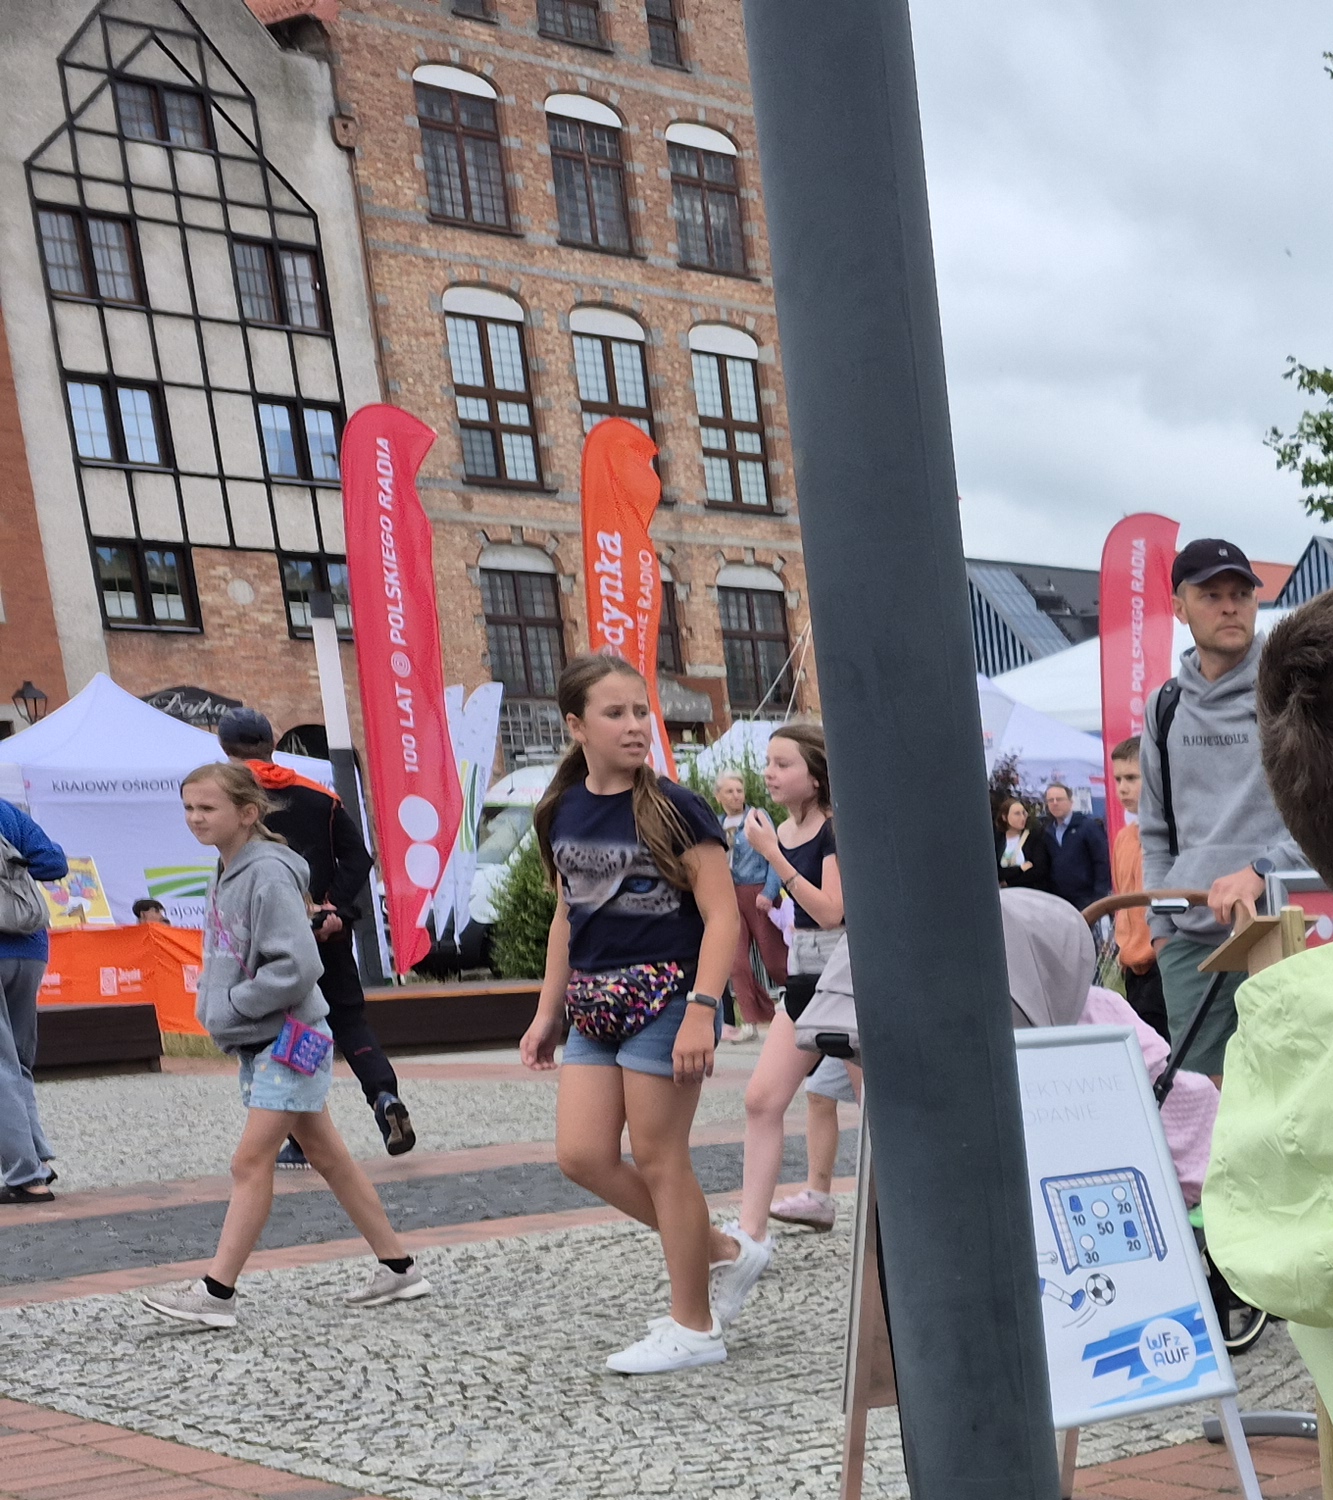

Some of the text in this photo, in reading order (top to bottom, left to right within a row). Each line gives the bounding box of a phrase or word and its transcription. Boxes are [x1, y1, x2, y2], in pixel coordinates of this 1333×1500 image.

[594, 531, 634, 658] edynka
[376, 437, 419, 773] 100 LAT POLSKIEGO RADIA
[636, 549, 653, 676] OLSKIE RADIO
[1131, 538, 1146, 693] POLSKIEGO RADIA
[51, 780, 118, 793] KRAJOWY
[1117, 1202, 1132, 1215] 20
[1072, 1214, 1086, 1228] 10
[1096, 1221, 1114, 1236] 50
[1126, 1239, 1141, 1252] 20
[1084, 1251, 1100, 1264] 30
[1153, 1346, 1190, 1367] AWF
